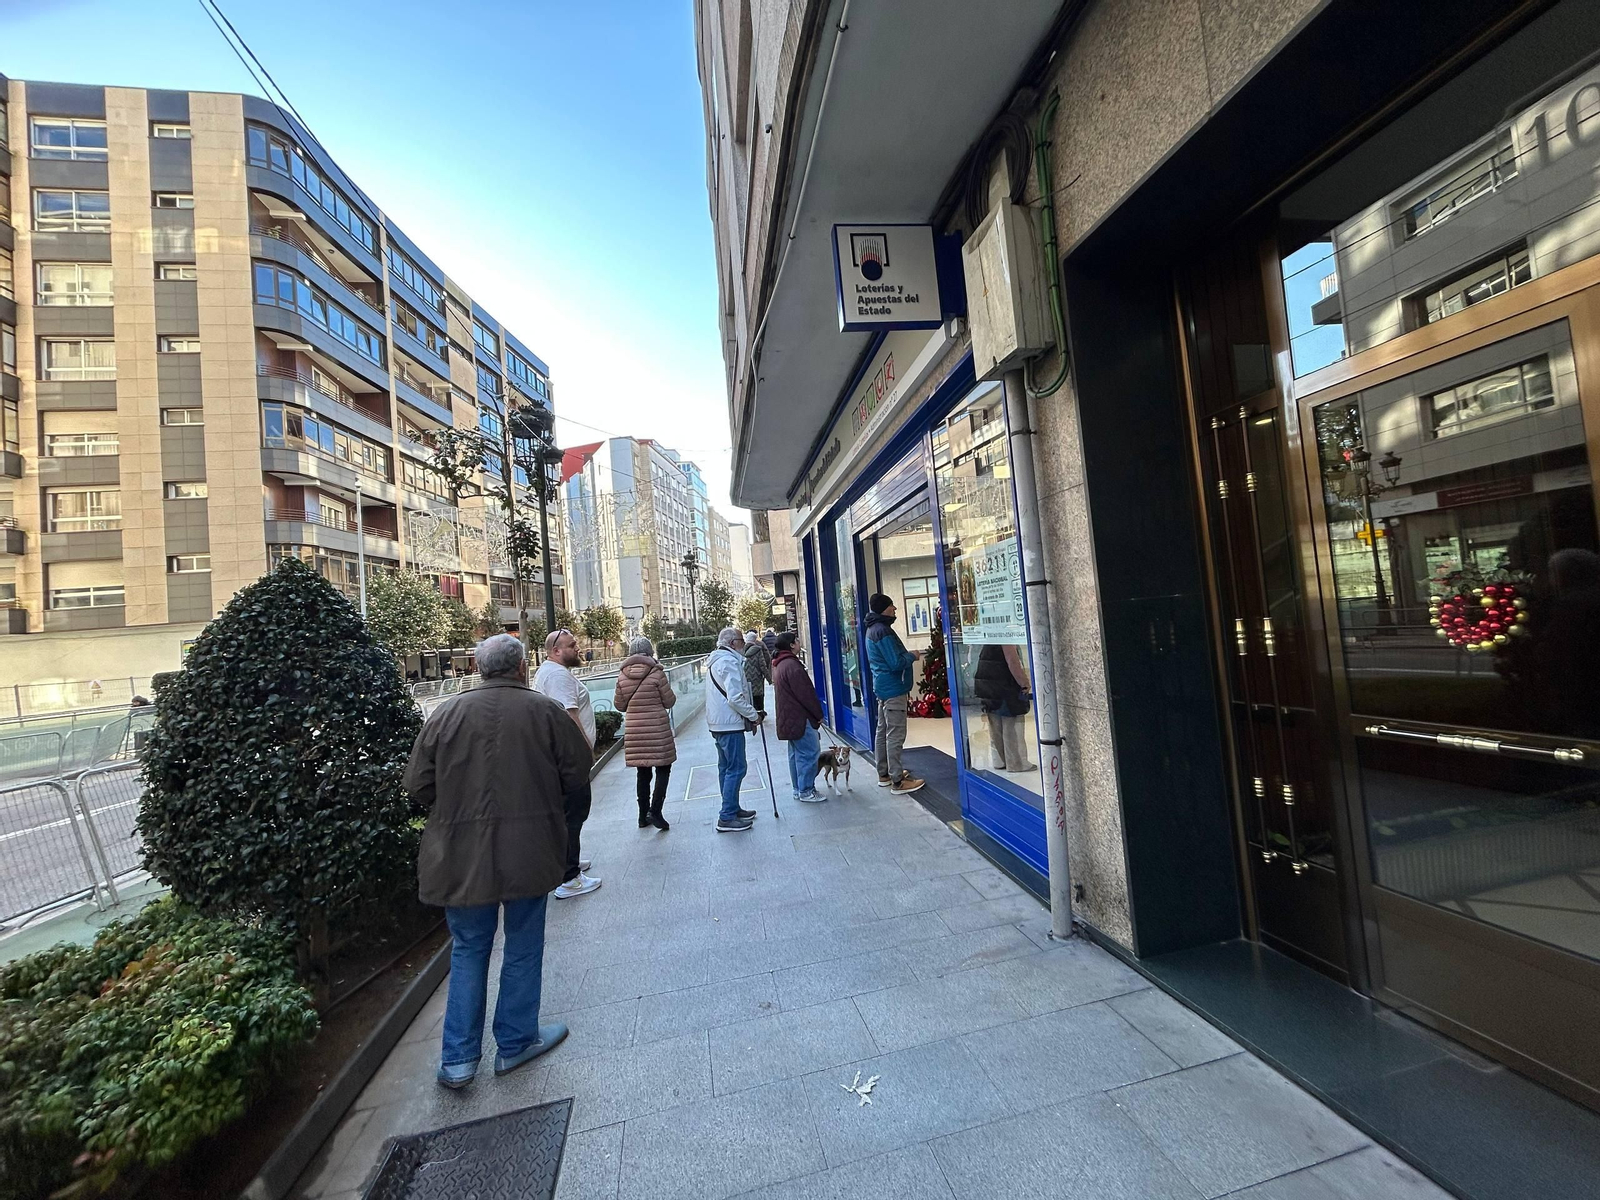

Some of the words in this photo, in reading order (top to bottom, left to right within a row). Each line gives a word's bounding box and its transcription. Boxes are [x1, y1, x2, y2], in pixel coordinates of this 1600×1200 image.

[855, 283, 895, 294] Loterías
[898, 285, 903, 294] y
[857, 295, 902, 306] Apuestas
[905, 294, 919, 304] del
[858, 306, 892, 315] Estado
[975, 553, 1006, 575] 36211
